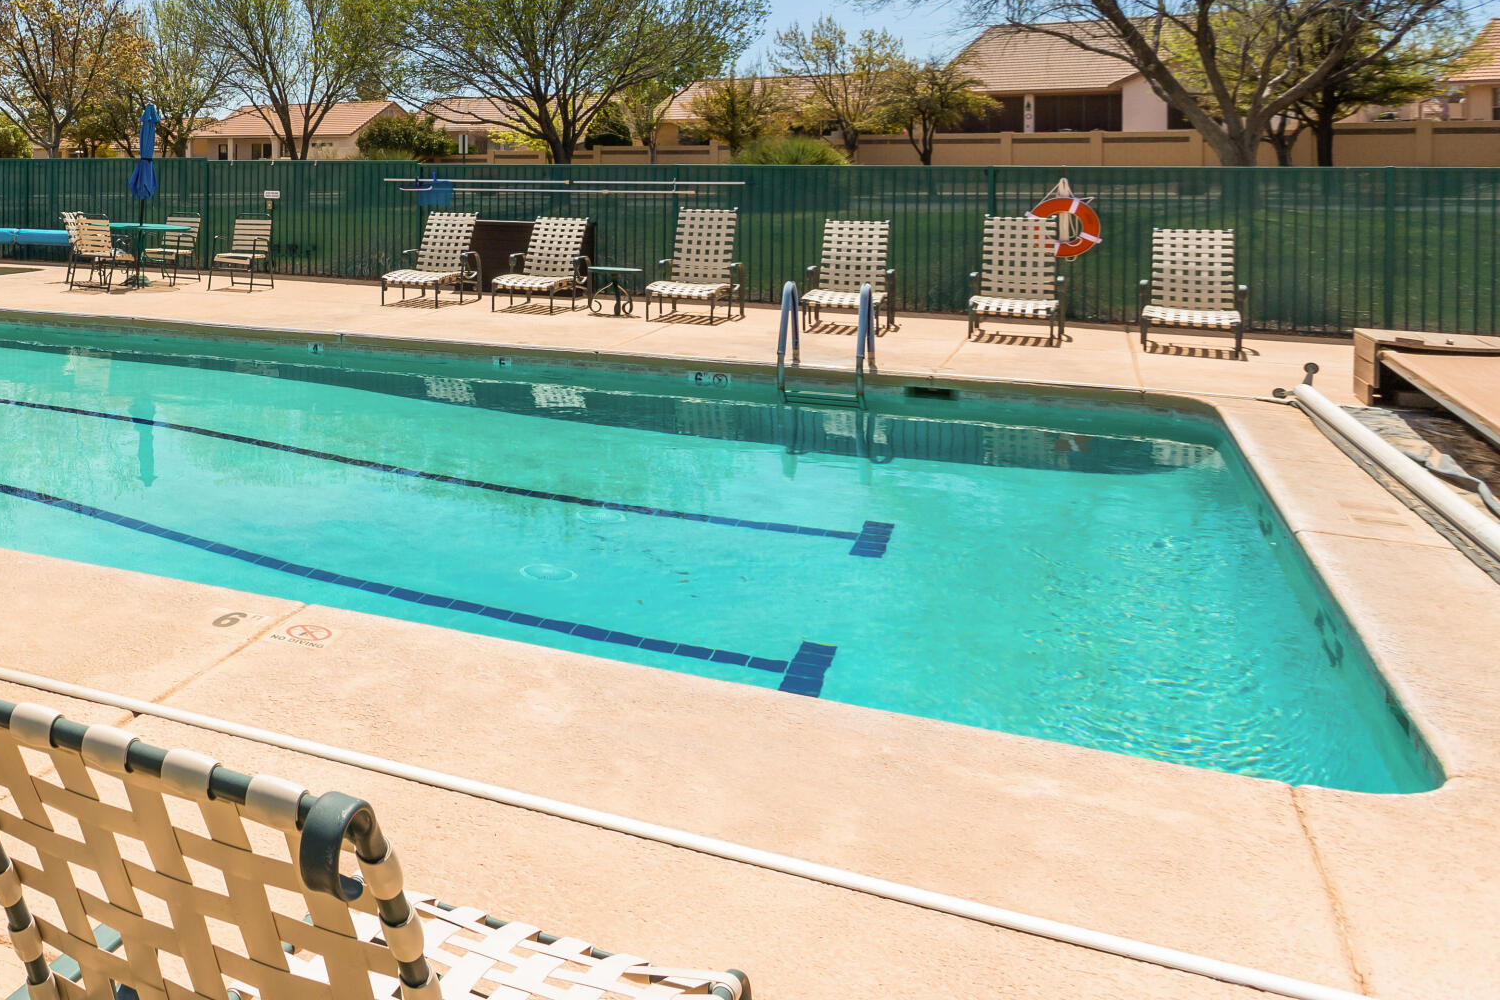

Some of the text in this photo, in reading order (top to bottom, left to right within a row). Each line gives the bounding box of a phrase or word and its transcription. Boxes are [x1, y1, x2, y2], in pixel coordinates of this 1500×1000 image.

[211, 612, 247, 627] 6
[270, 633, 325, 649] NO DIVING
